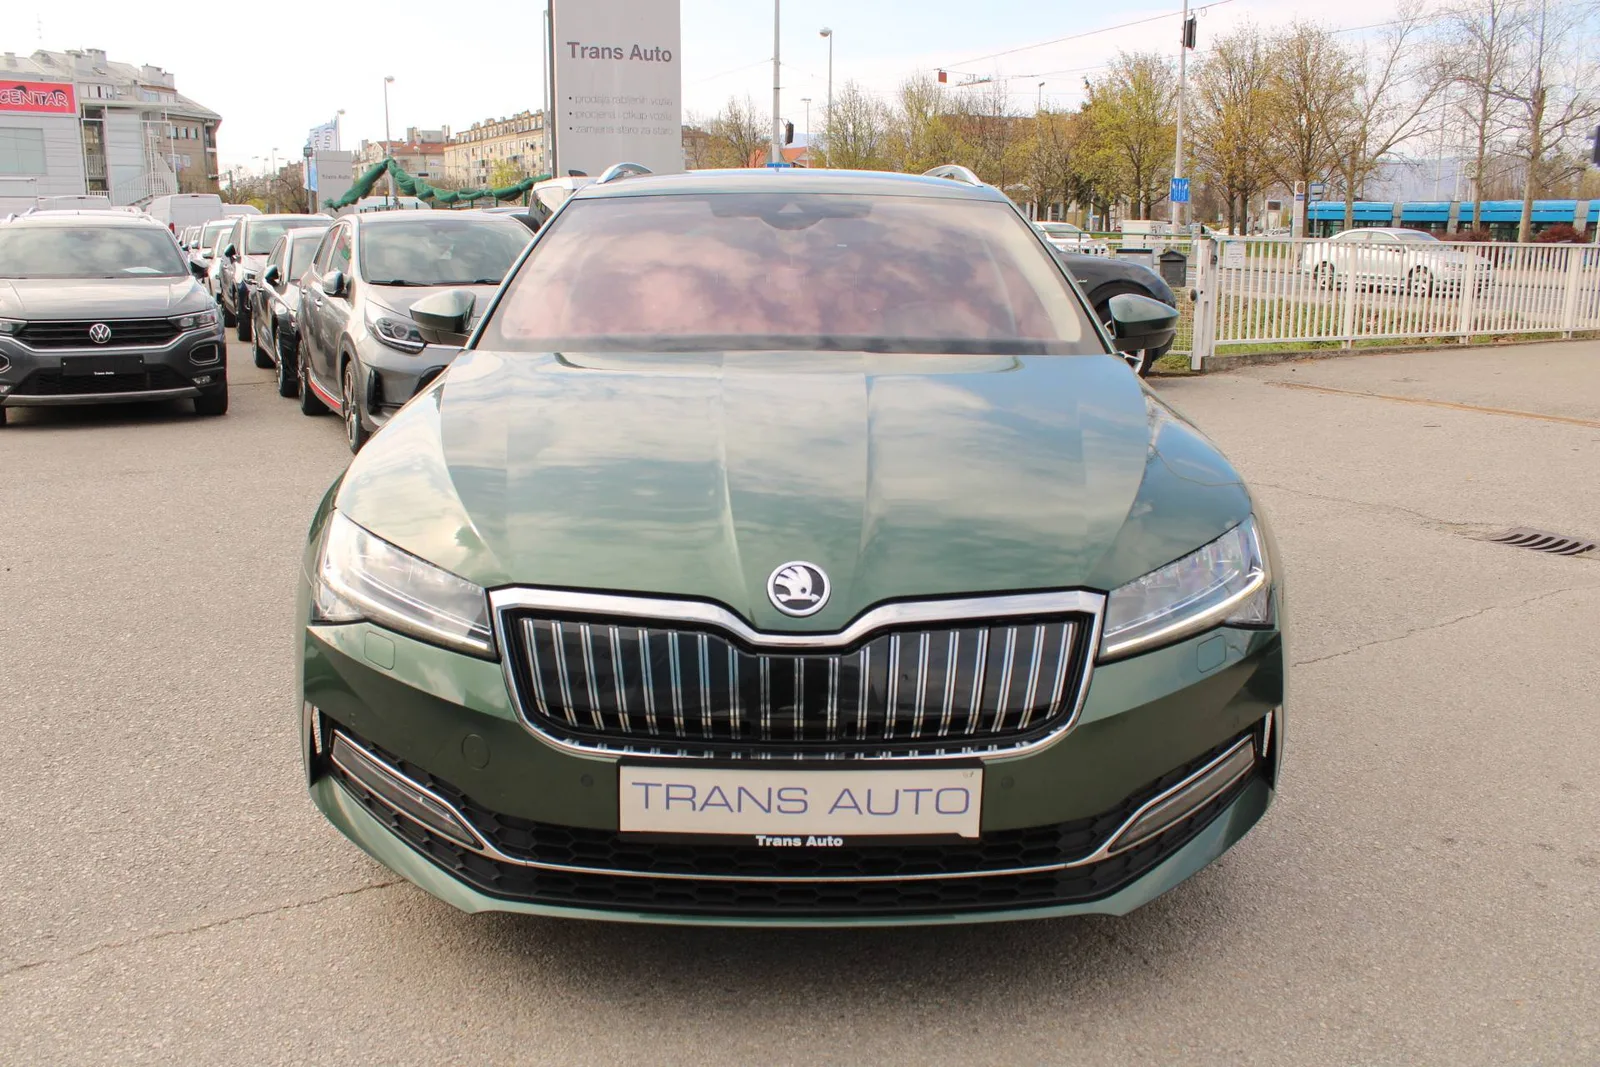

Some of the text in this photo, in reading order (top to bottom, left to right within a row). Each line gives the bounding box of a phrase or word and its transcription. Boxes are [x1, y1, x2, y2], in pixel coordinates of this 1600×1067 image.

[567, 41, 672, 62] Trans Auto
[0, 89, 69, 107] CENTAR
[632, 782, 970, 816] TRANS AUTO
[756, 835, 843, 847] Trans Auto
